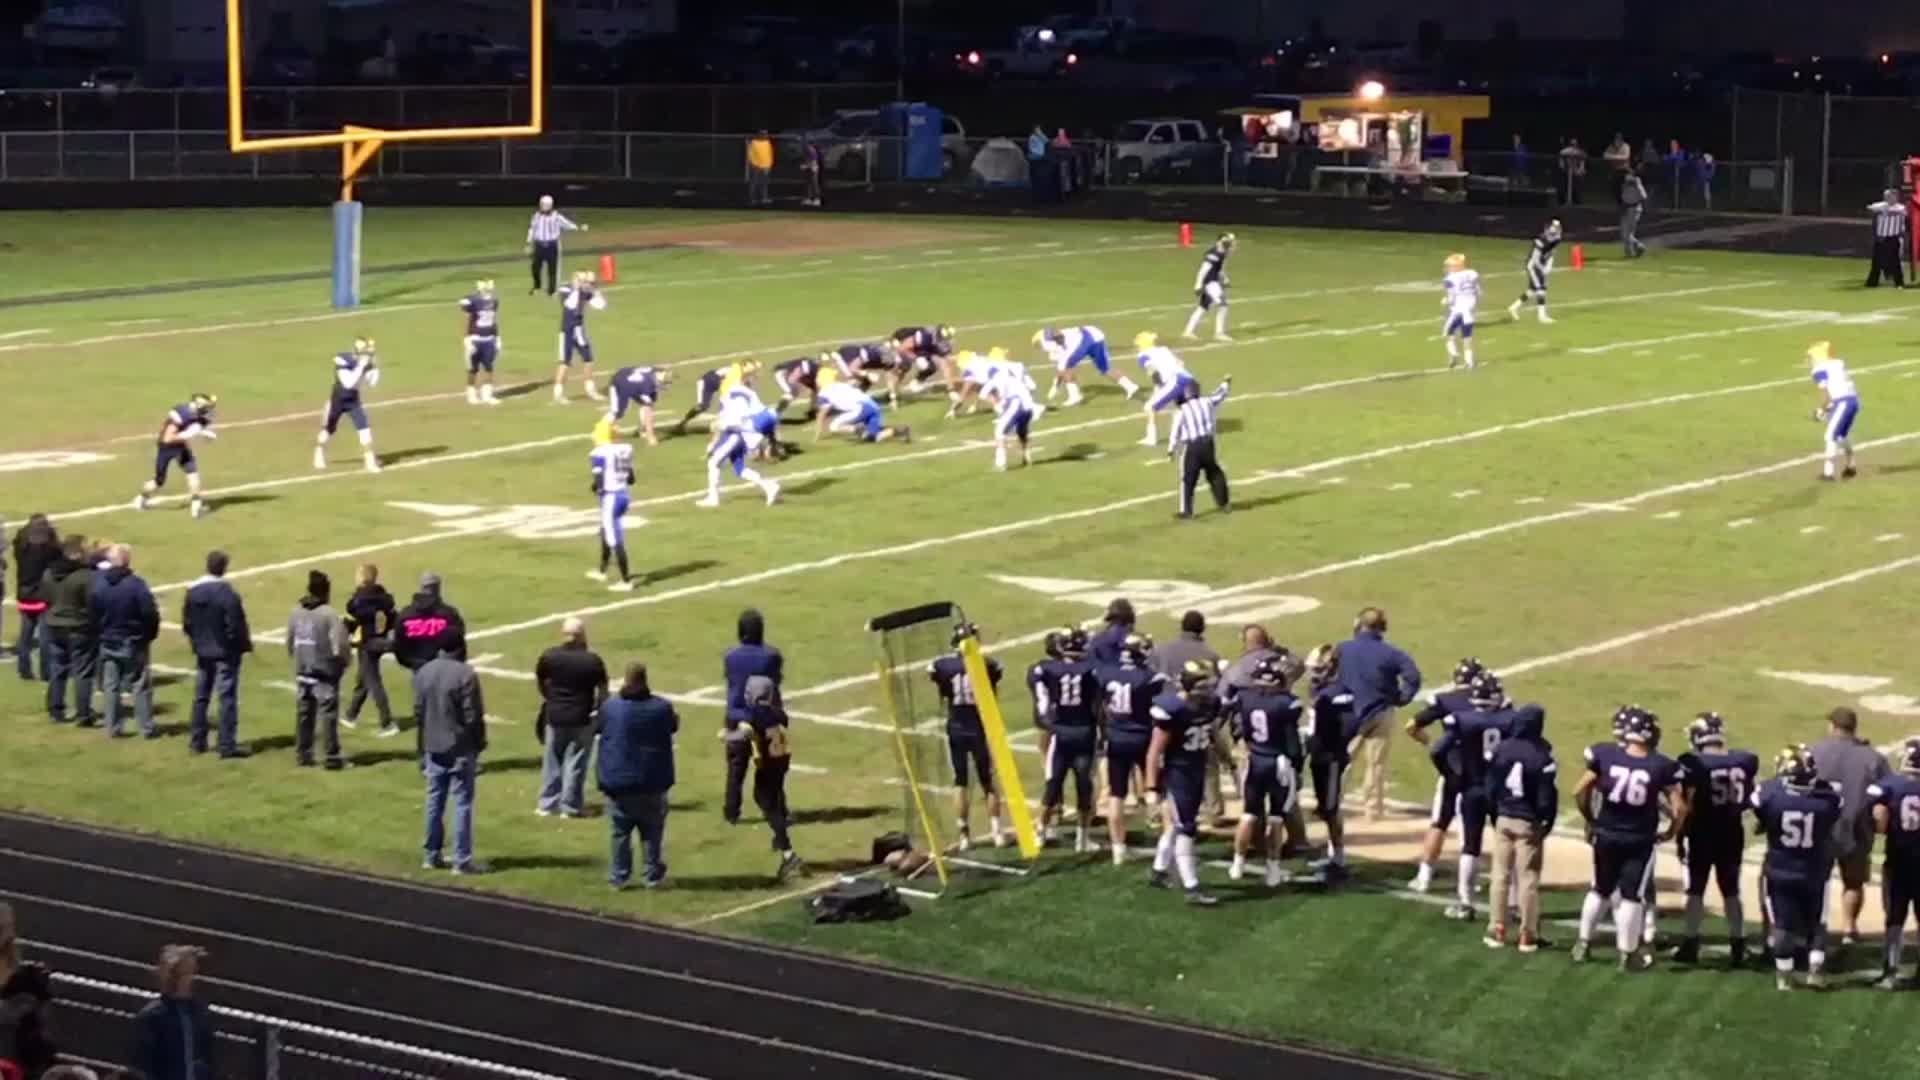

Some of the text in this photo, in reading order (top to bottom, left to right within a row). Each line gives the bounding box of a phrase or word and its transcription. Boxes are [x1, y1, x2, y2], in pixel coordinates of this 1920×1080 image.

[1060, 673, 1082, 706] 11
[1107, 681, 1132, 714] 31
[1251, 709, 1269, 743] 9
[1505, 761, 1524, 797] 4
[1608, 765, 1650, 806] 76
[1710, 767, 1746, 806] 56
[1780, 810, 1815, 848] 51
